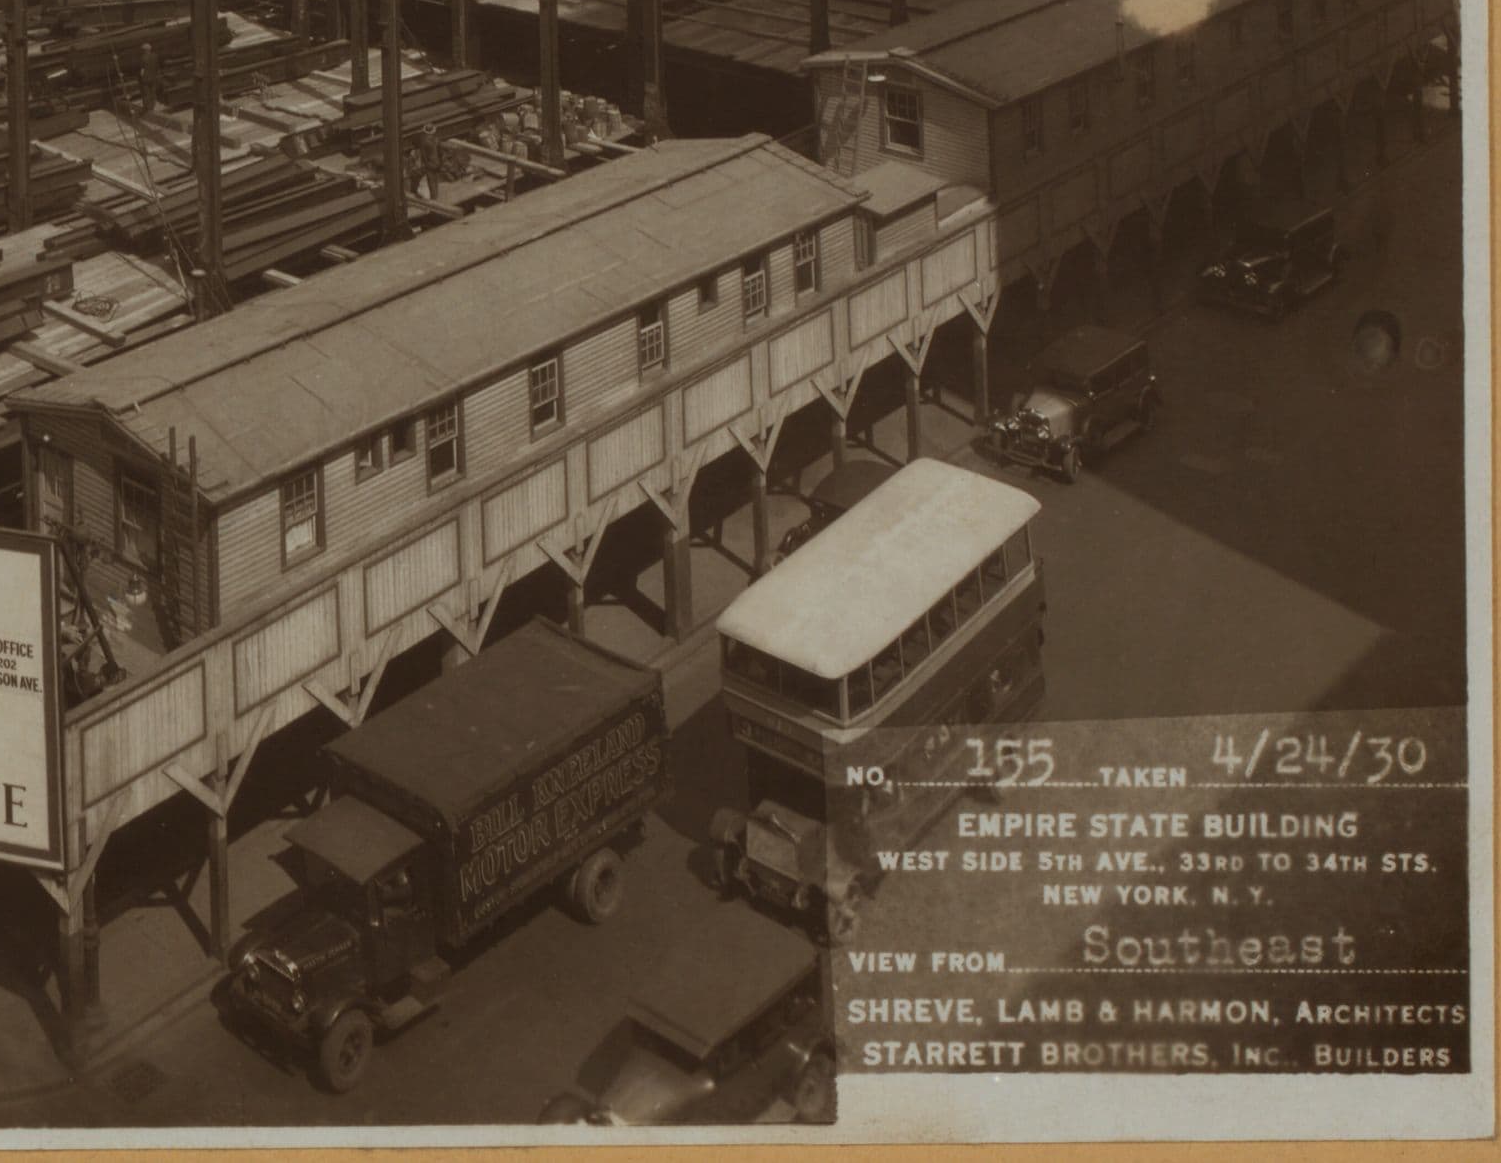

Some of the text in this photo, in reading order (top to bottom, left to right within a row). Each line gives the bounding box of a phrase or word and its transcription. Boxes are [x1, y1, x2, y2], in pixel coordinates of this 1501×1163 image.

[20, 676, 44, 694] AVE.
[460, 812, 550, 903] MOTOR
[552, 741, 662, 839] EXPRESS
[469, 794, 525, 855] BILL
